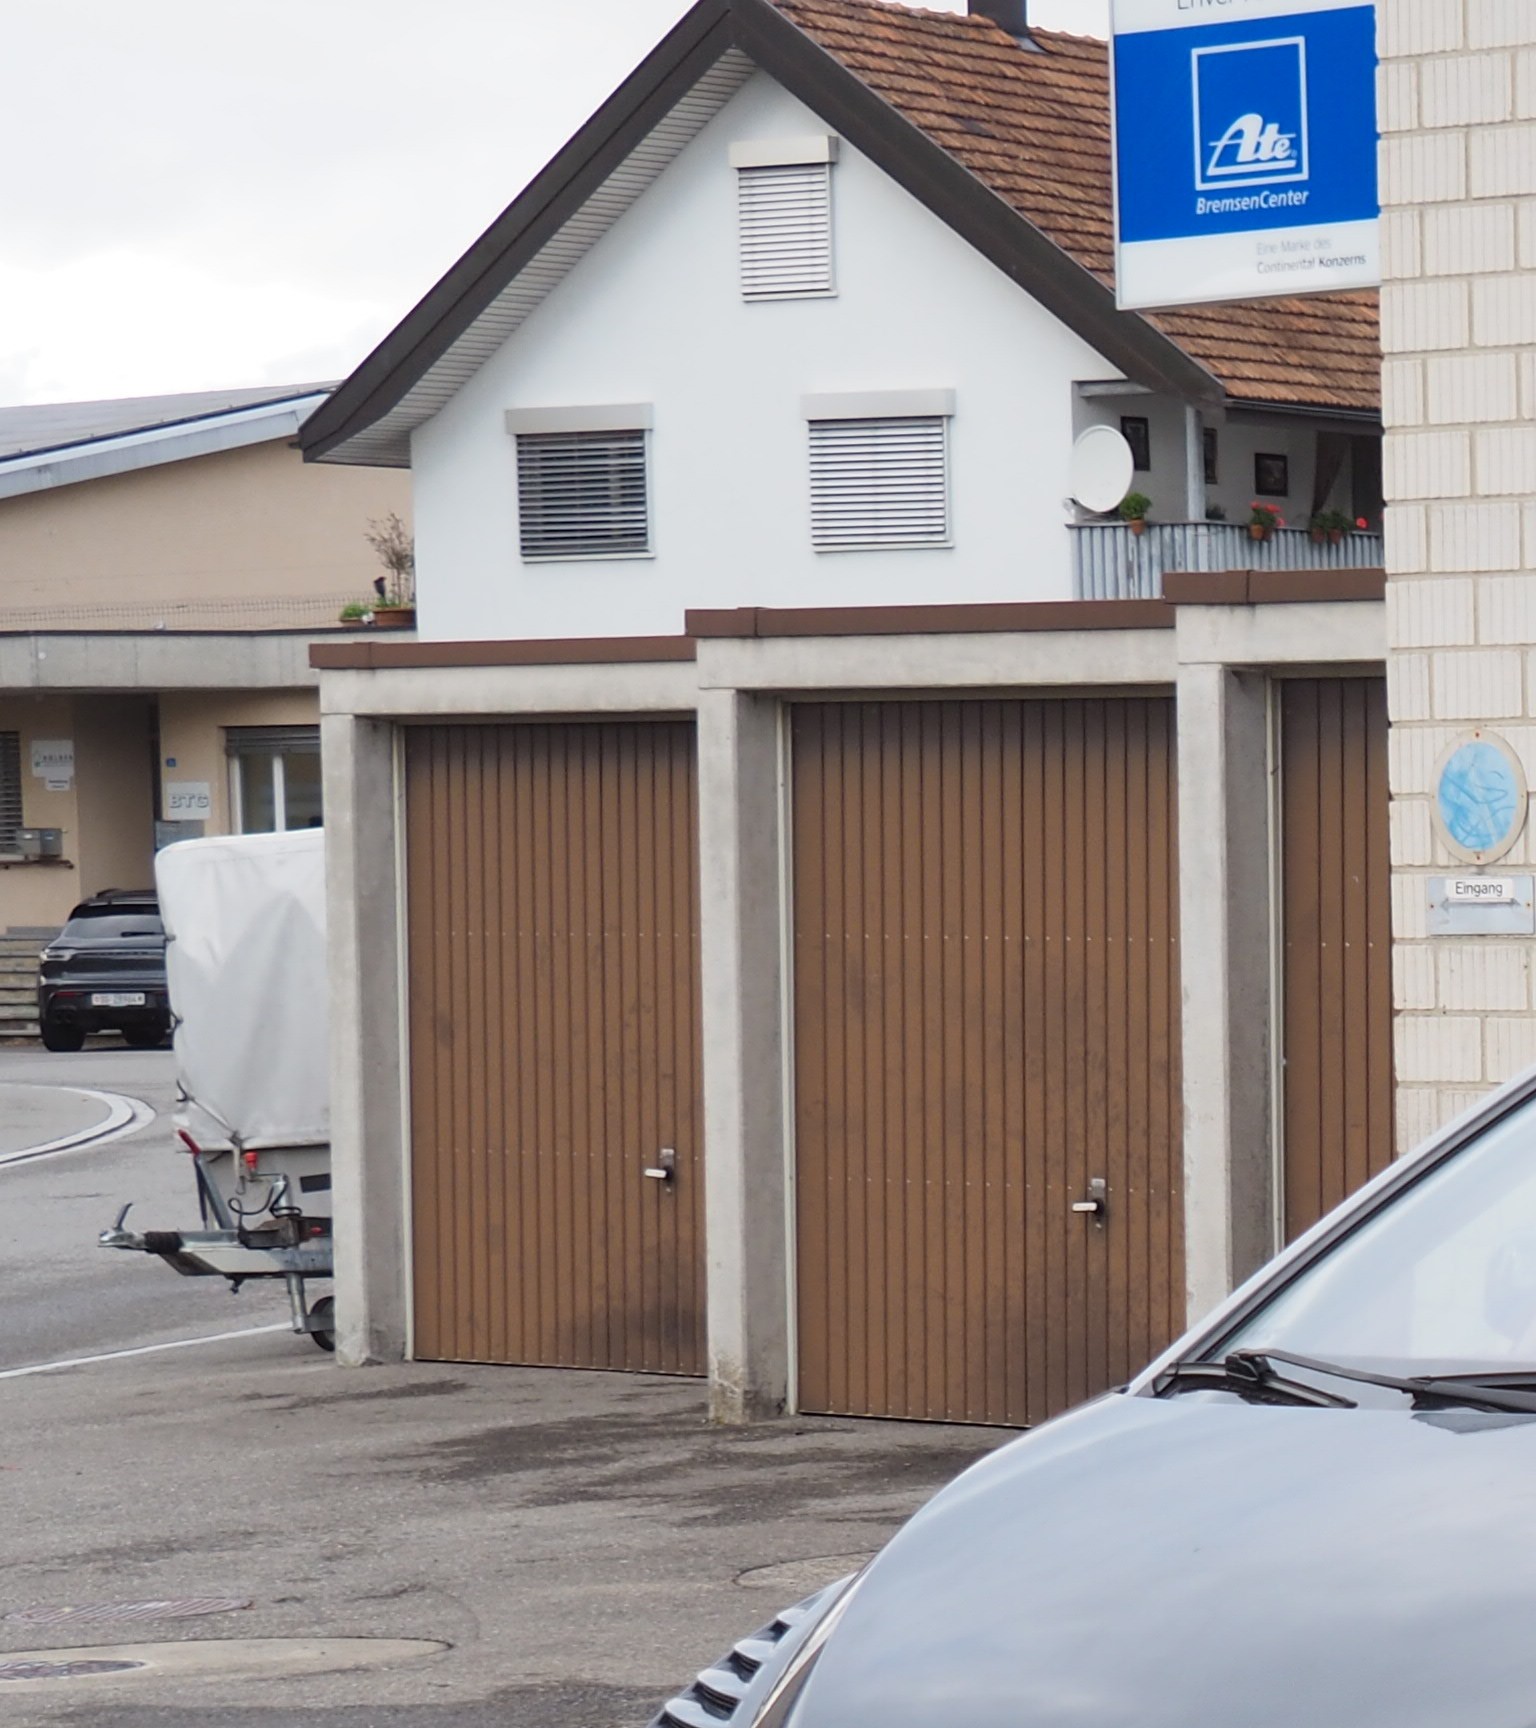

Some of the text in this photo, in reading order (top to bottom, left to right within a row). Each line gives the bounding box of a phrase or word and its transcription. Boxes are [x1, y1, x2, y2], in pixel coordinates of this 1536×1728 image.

[1206, 113, 1297, 176] Ate
[1196, 190, 1309, 215] BremsenCenter
[1257, 254, 1367, 274] Continental Konzerns
[1455, 882, 1503, 897] Eingang
